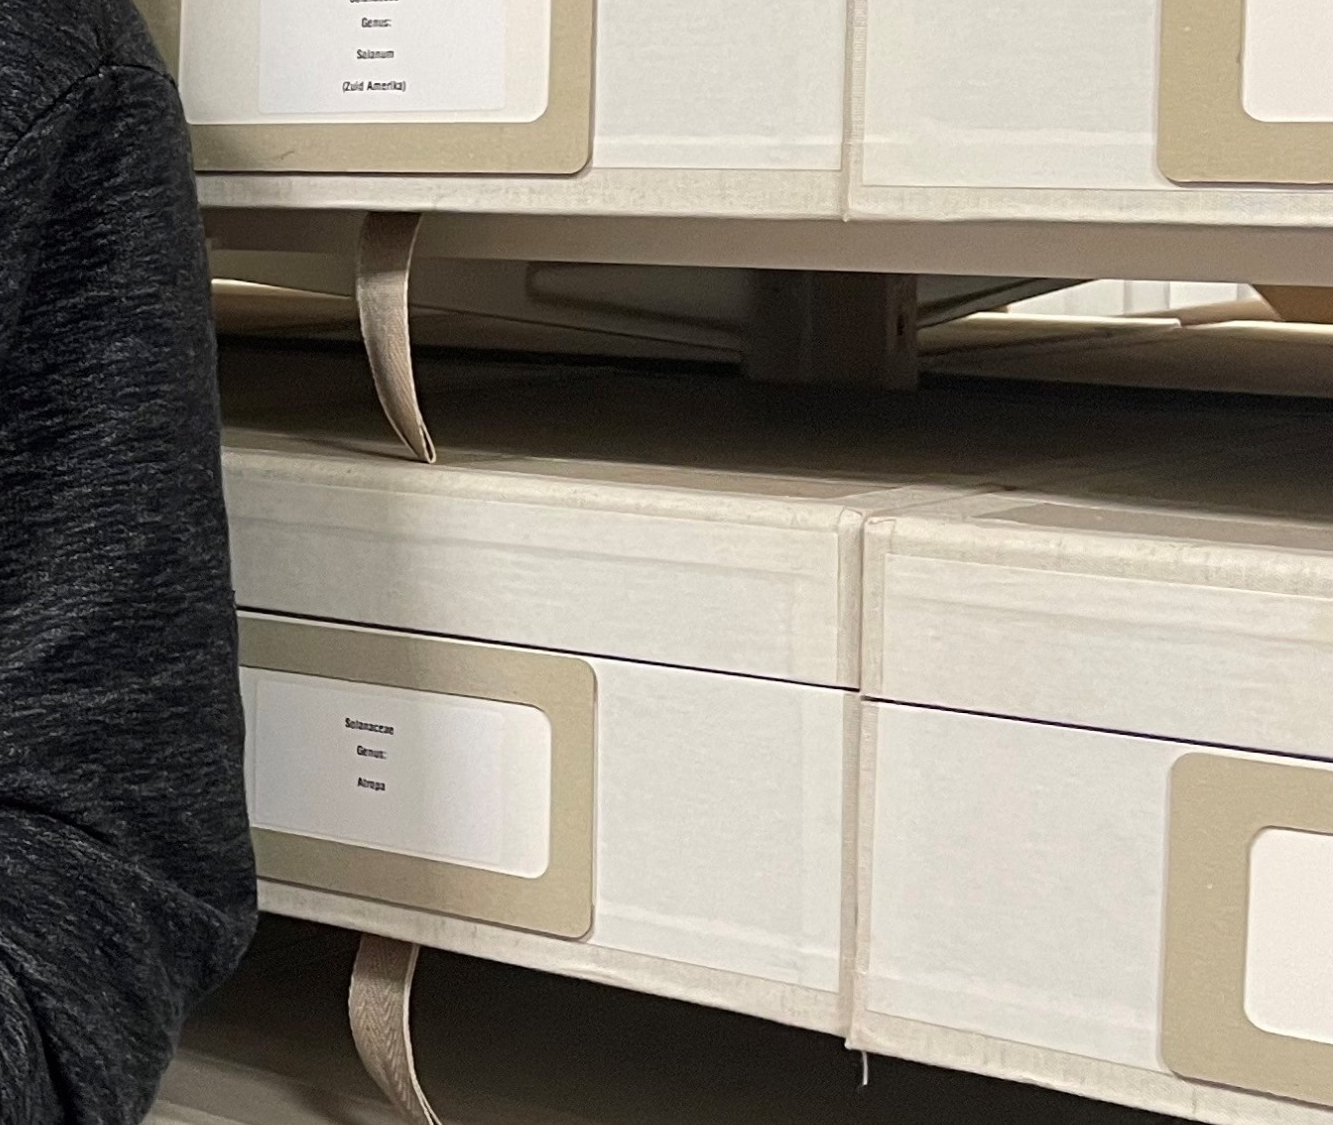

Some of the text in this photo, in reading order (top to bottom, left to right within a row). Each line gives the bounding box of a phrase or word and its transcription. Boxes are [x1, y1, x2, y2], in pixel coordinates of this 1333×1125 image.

[356, 49, 394, 60] Solanum
[342, 80, 406, 93] (Zuid Amerika)
[345, 717, 394, 735] Solanaceae
[357, 777, 385, 791] Atropa
